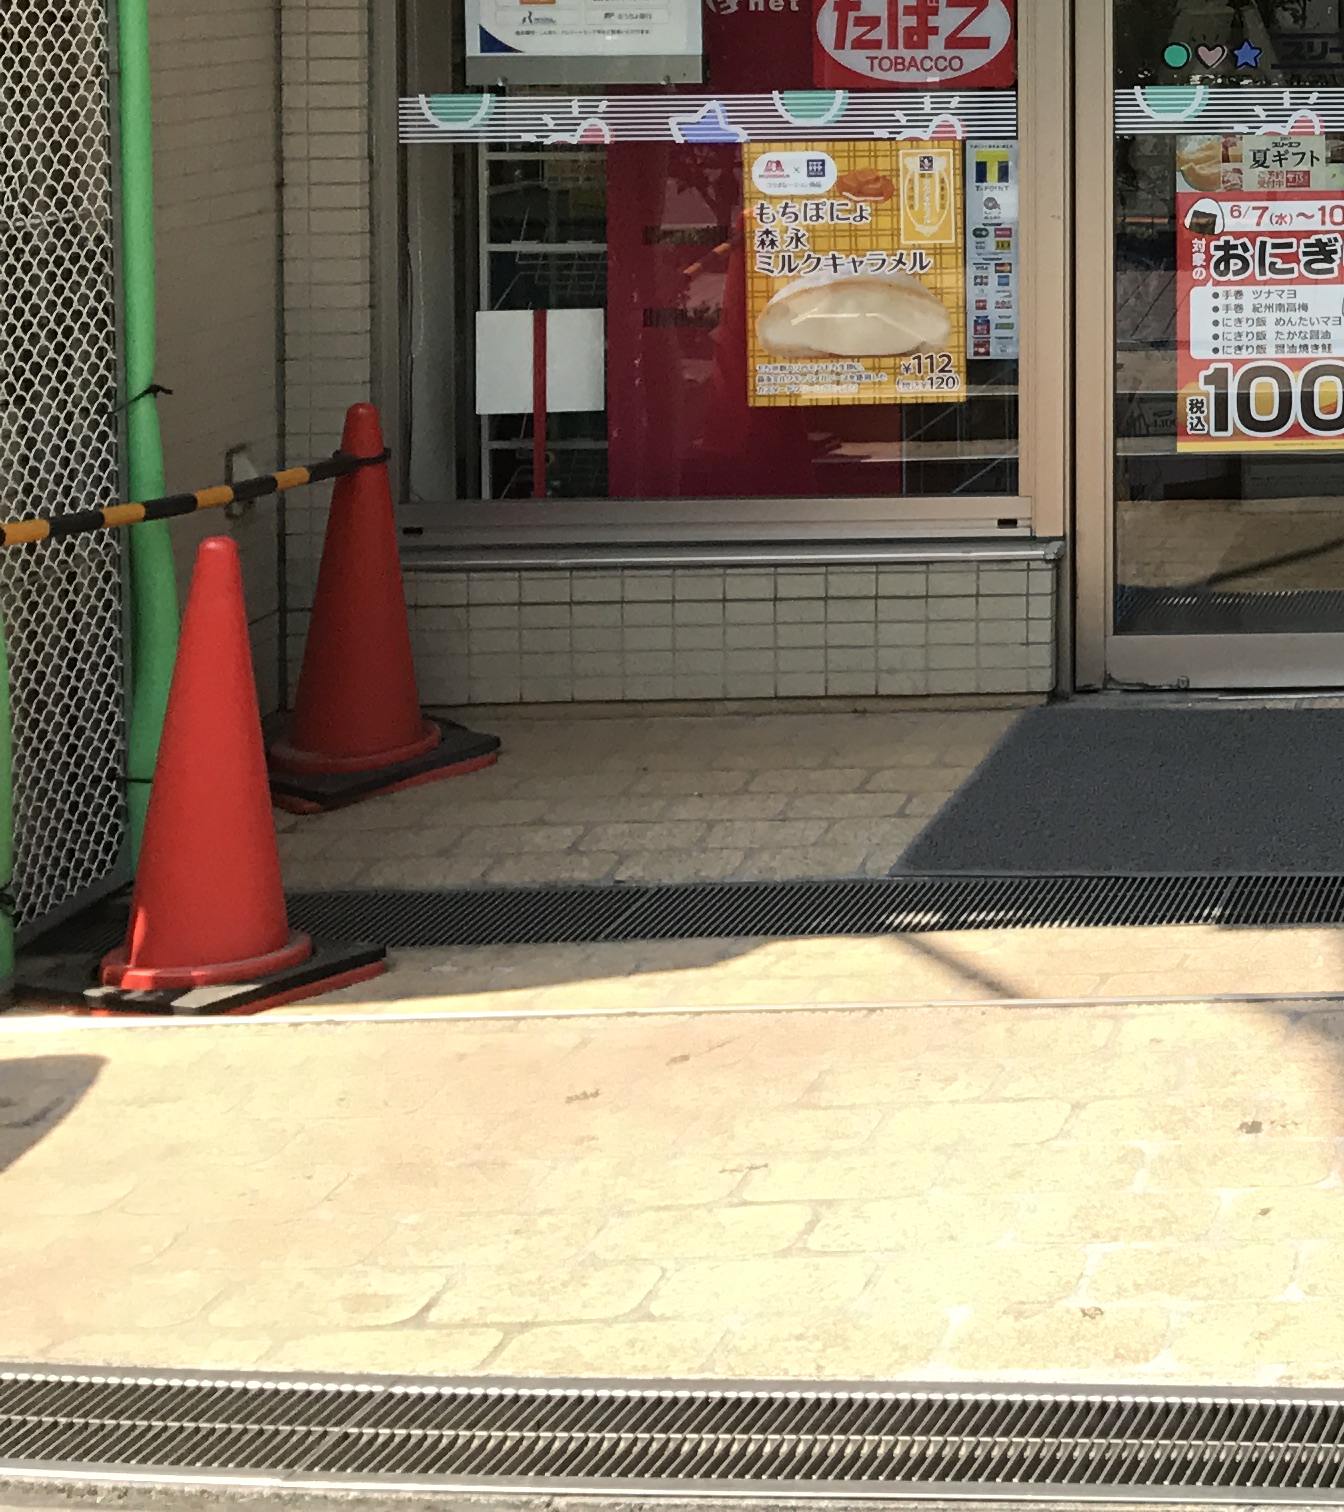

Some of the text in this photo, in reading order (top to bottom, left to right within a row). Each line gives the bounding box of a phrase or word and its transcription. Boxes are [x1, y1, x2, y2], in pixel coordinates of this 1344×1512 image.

[864, 54, 964, 73] TOBACCO
[1249, 148, 1320, 169] 夏ギフト
[755, 201, 870, 224] もちぽにょ
[756, 227, 809, 250] 森永
[756, 251, 932, 274] ミルクキャラメル
[1222, 289, 1298, 299] 手巻 ツナマヨ
[1222, 302, 1309, 314] 手巻 紀州南高梅
[1222, 316, 1342, 327] にぎり飯 めんたいマヨ
[1222, 330, 1332, 341] にぎり飯 たかな醤油
[1222, 345, 1267, 355] にぎり飯
[902, 353, 954, 375] ¥112
[1188, 397, 1207, 433] 税込
